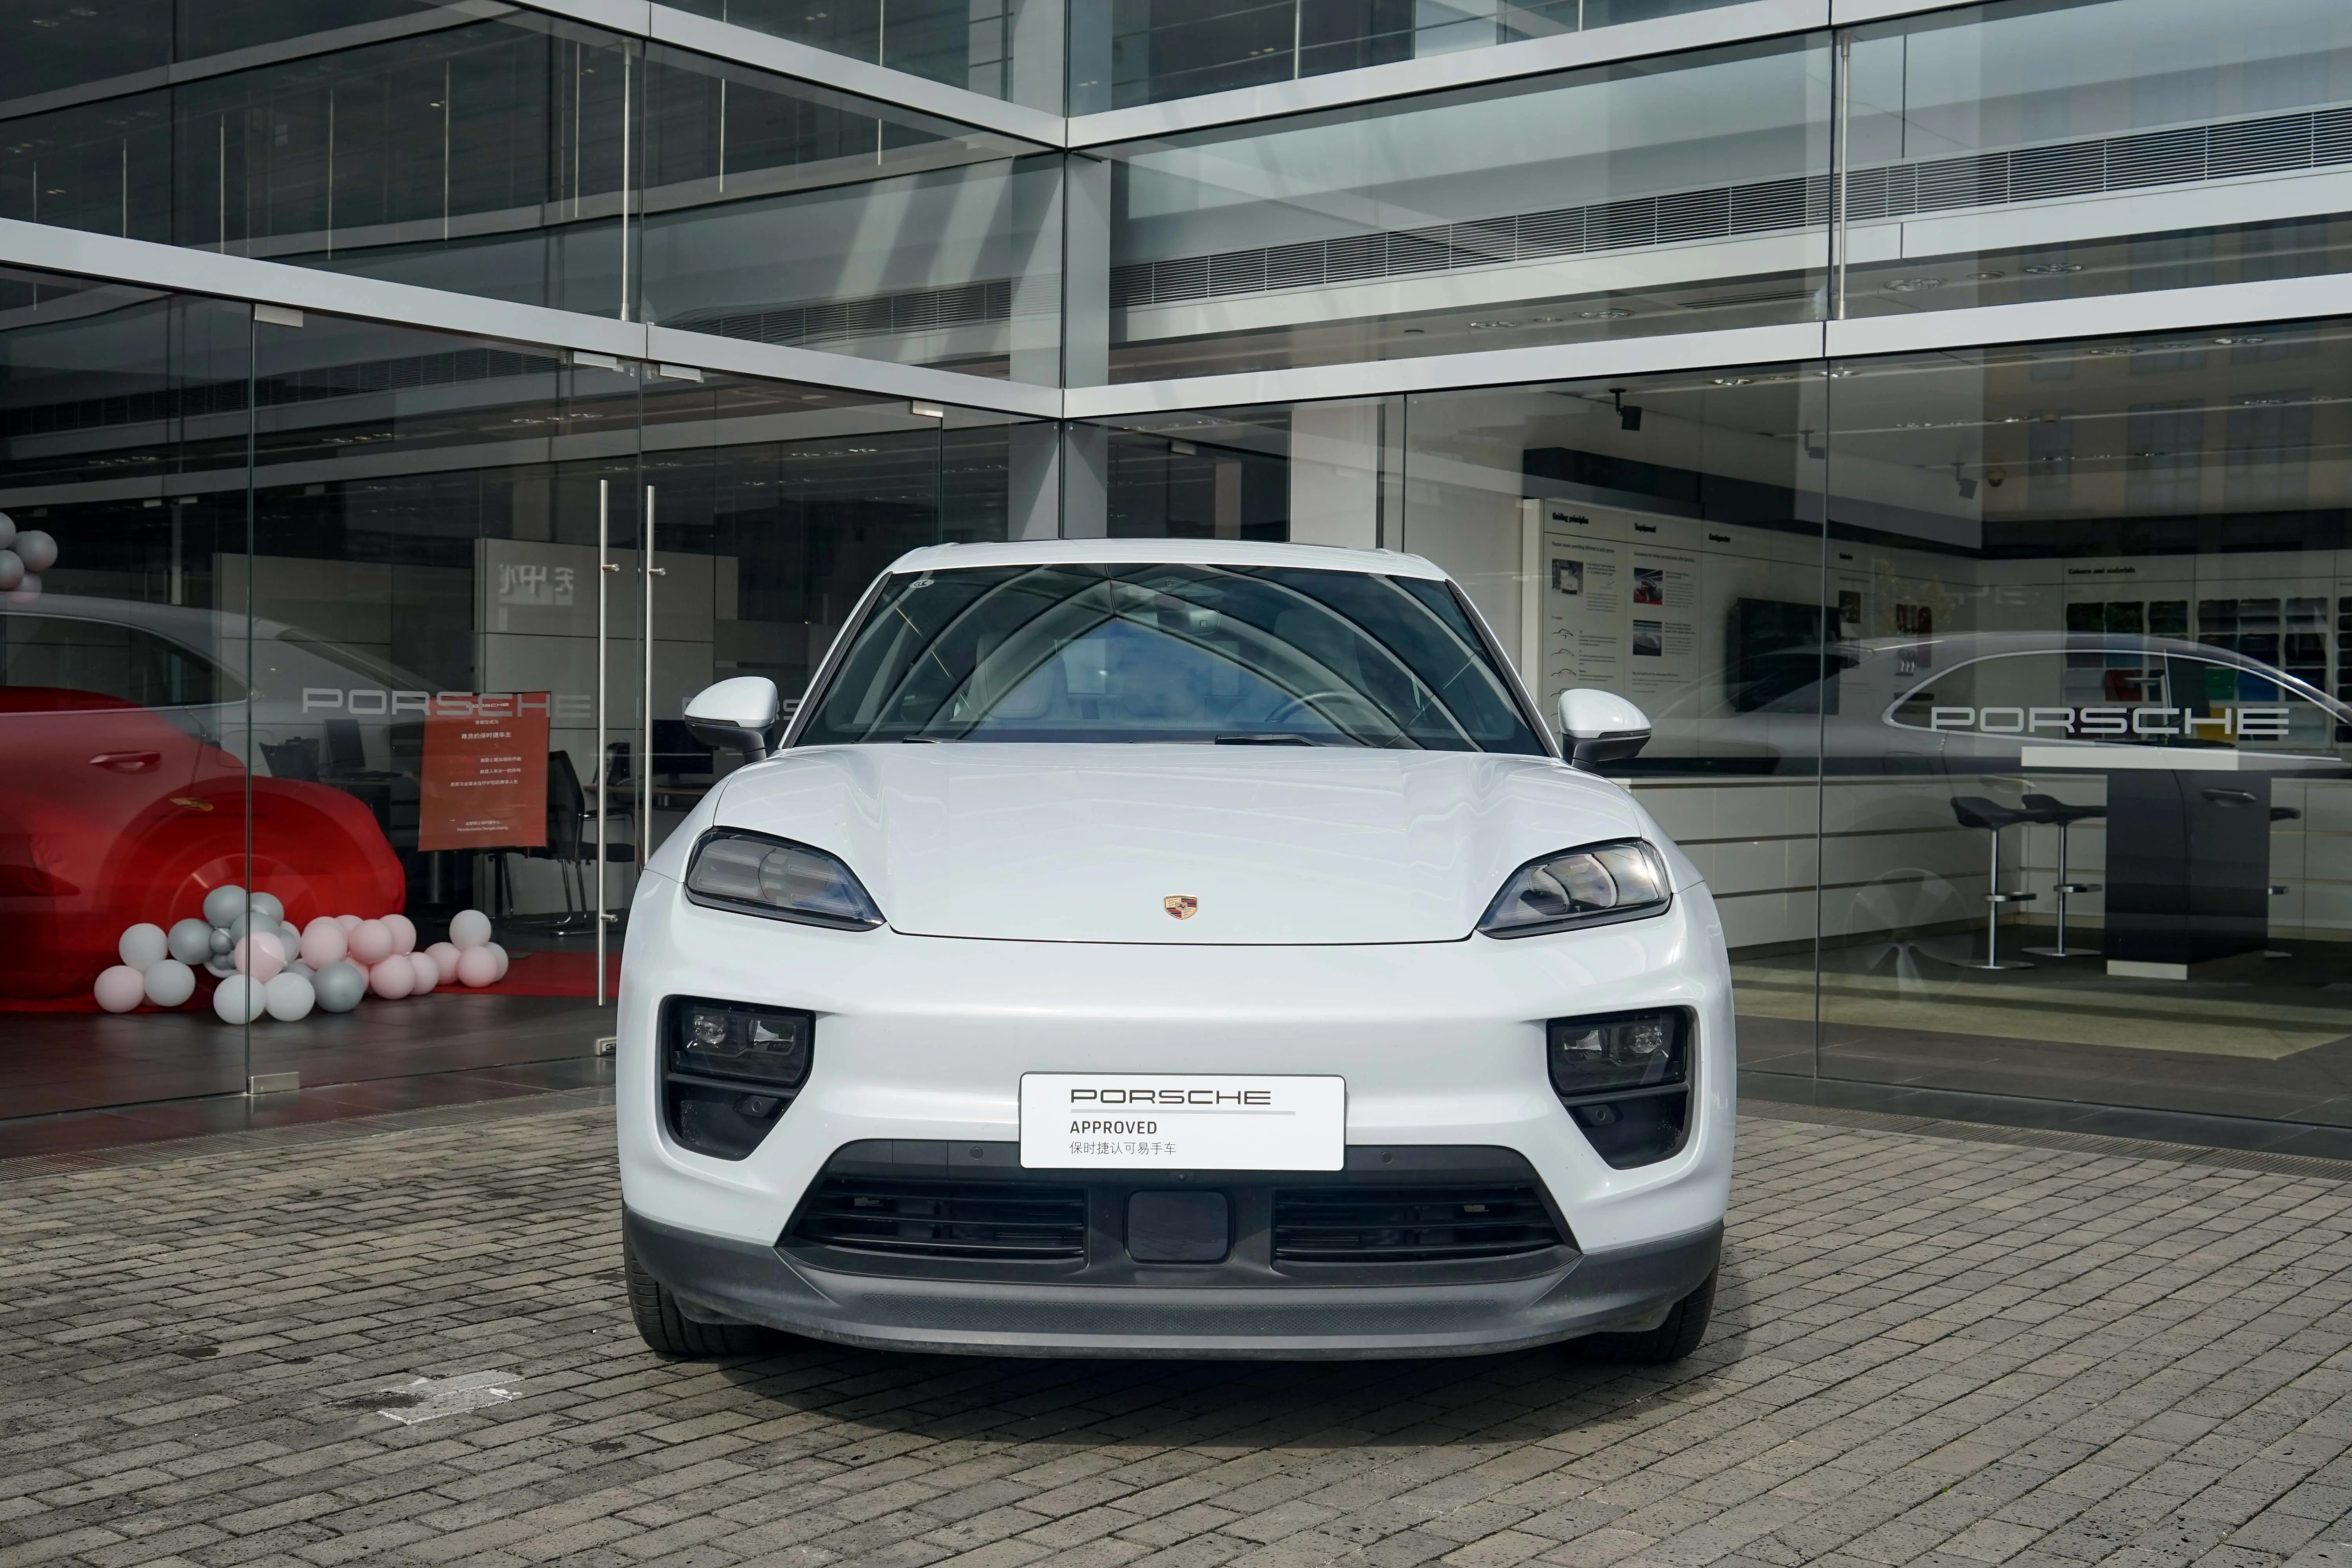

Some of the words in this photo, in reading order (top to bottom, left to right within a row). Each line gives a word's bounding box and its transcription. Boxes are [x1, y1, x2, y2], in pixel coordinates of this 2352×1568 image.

[302, 688, 591, 718] PORSCHE
[1931, 707, 2289, 735] PORSCHE
[461, 731, 512, 740] 尊贵的保时捷车主
[1071, 1089, 1271, 1105] PORSCHE
[1070, 1120, 1158, 1134] APPROVED
[1069, 1141, 1177, 1155] 保时捷认可易手车
